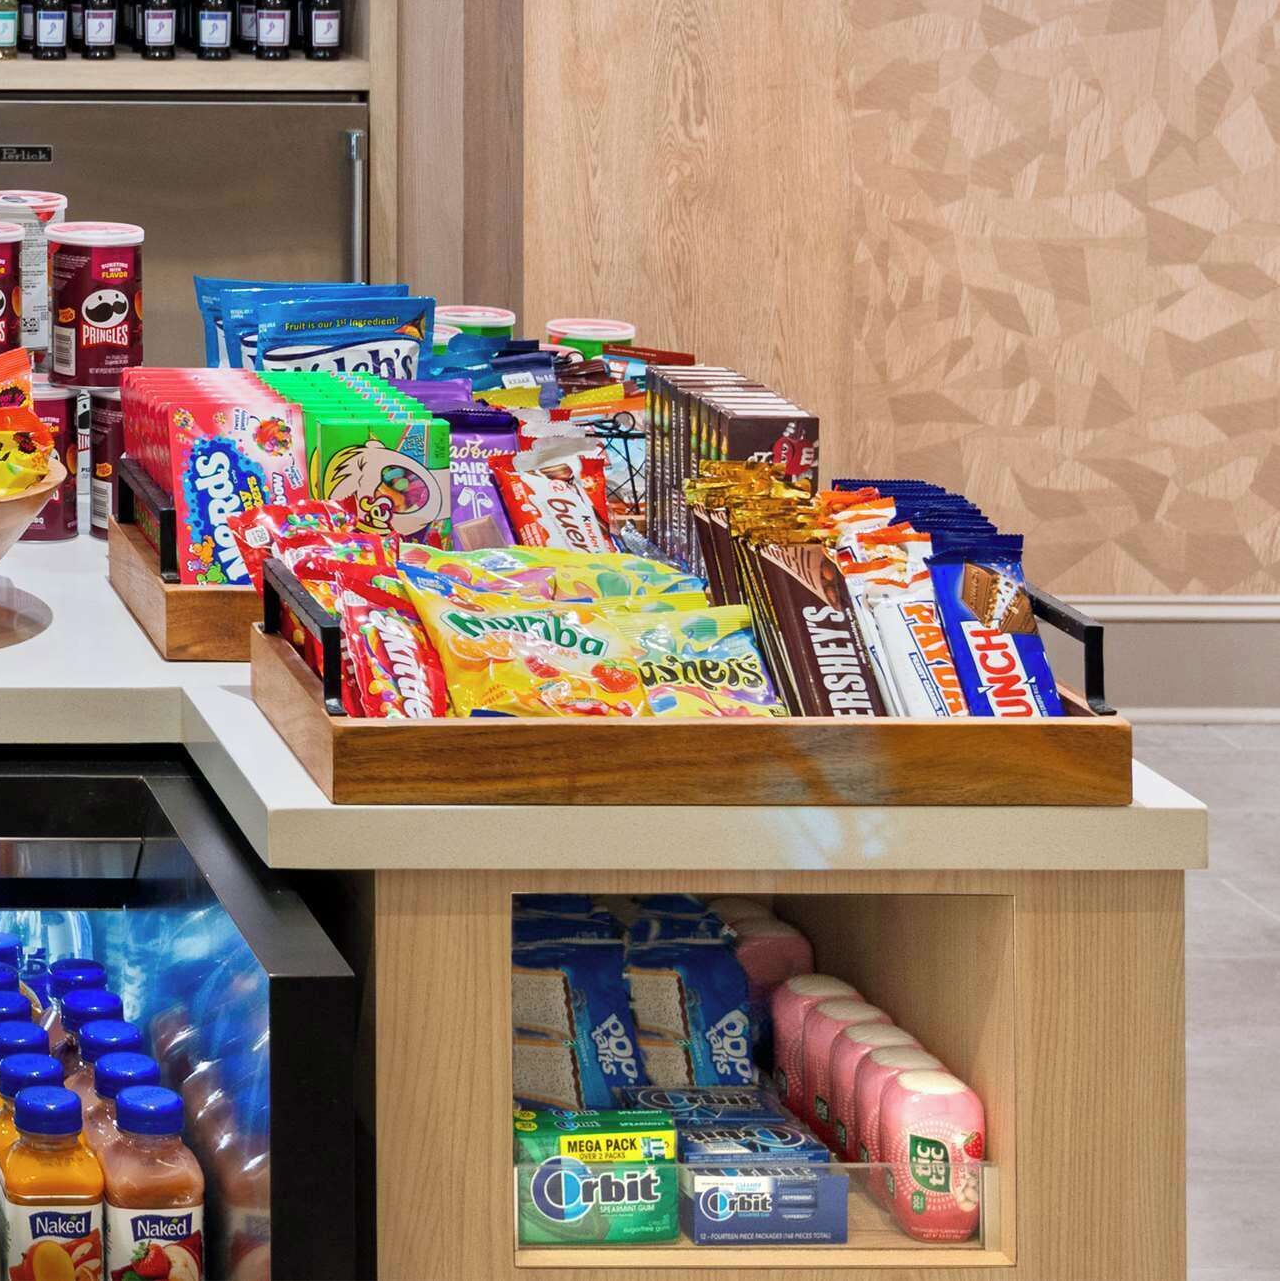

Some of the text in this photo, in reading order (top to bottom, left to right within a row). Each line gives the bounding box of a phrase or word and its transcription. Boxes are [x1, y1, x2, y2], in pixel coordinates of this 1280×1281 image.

[82, 323, 129, 346] PRINGLES
[285, 322, 306, 332] Fruit
[307, 321, 315, 330] is
[318, 322, 333, 330] our
[349, 317, 400, 328] Ingredient!
[453, 474, 493, 487] MILK
[969, 628, 1035, 718] UNCH
[567, 1138, 638, 1153] MEGA PACK
[912, 1140, 931, 1179] tic
[929, 1144, 946, 1186] tac
[531, 1155, 661, 1223] Orbit
[700, 1186, 773, 1222] Orbit
[35, 1217, 86, 1235] Naked
[137, 1219, 187, 1238] Naked
